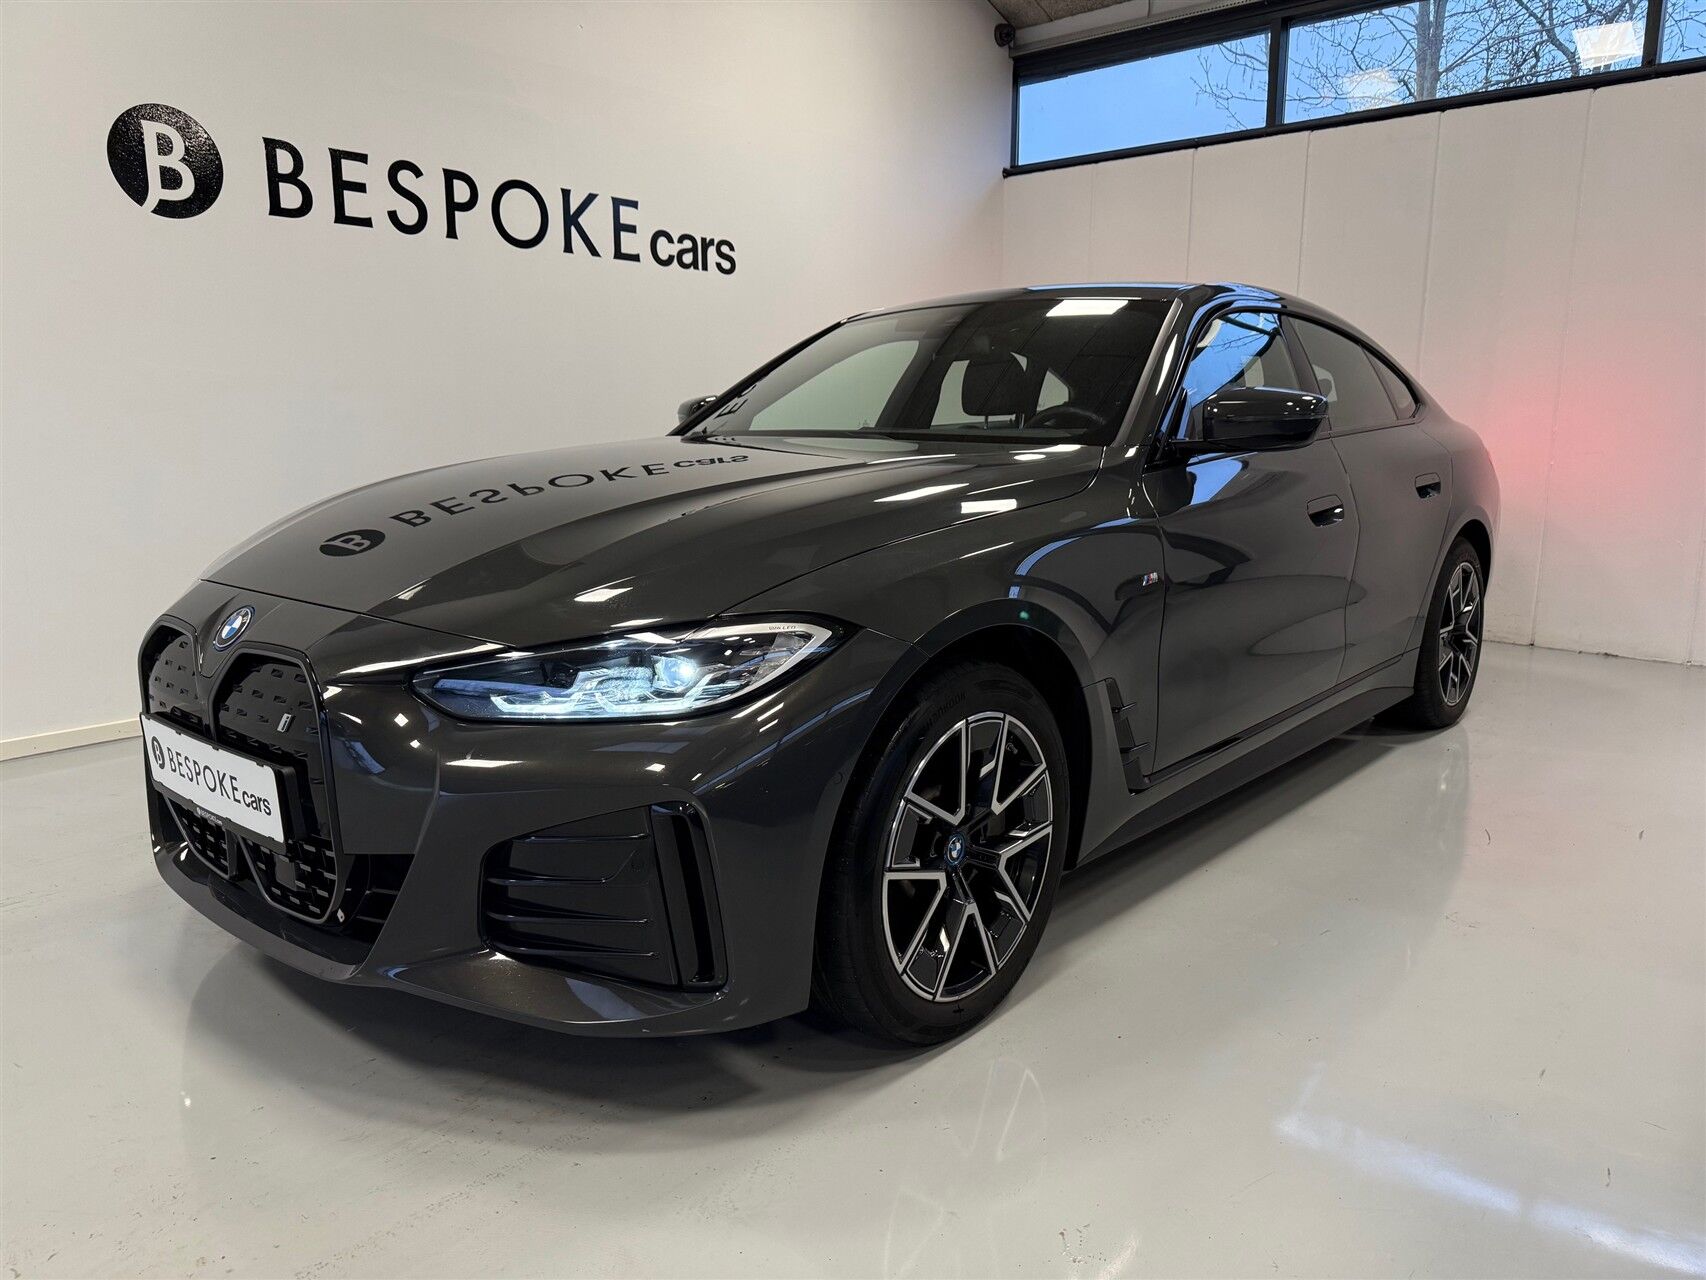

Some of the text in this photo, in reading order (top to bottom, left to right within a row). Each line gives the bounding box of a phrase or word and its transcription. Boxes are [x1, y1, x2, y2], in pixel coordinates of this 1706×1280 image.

[262, 137, 640, 262] BESPOKE
[650, 230, 737, 275] cars
[166, 746, 242, 804] BESPOKE
[242, 790, 272, 817] cars
